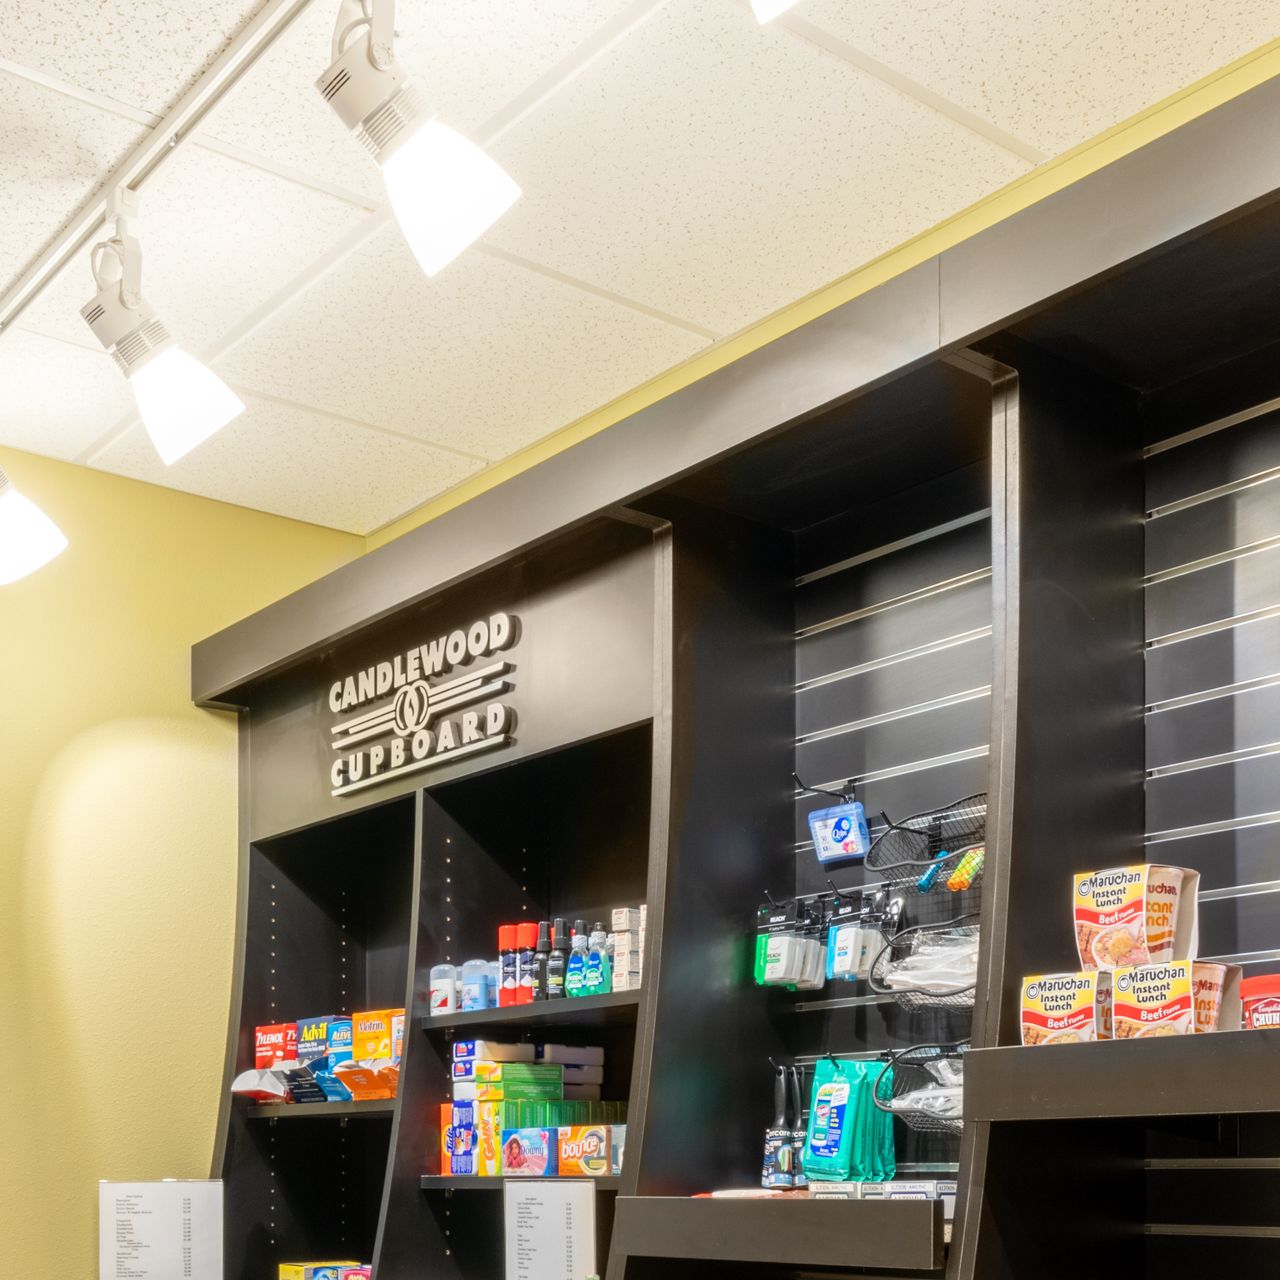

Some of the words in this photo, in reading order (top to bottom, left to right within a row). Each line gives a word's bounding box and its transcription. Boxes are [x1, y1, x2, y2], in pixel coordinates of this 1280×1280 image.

[329, 613, 511, 713] CANDLEWOOD
[331, 702, 507, 787] CUPBOARD
[1090, 872, 1140, 888] Maruchan
[1093, 886, 1126, 899] Instant
[1096, 898, 1122, 907] Lunch
[839, 906, 852, 914] REACH
[770, 915, 786, 923] REACH
[1099, 912, 1119, 924] Beef
[1129, 967, 1185, 982] Maruchan
[1038, 979, 1090, 992] Maruchan
[1133, 982, 1171, 994] Instant
[1041, 993, 1076, 1003] Instant
[1137, 993, 1167, 1003] Lunch
[1044, 1002, 1072, 1011] Lunch
[1141, 1008, 1163, 1020] Beef
[1048, 1018, 1068, 1028] Beef
[301, 1023, 327, 1041] Advil
[332, 1031, 352, 1040] ALEVE
[256, 1032, 283, 1046] TYLENOL
[520, 1145, 544, 1156] Downy
[561, 1137, 598, 1159] bounce
